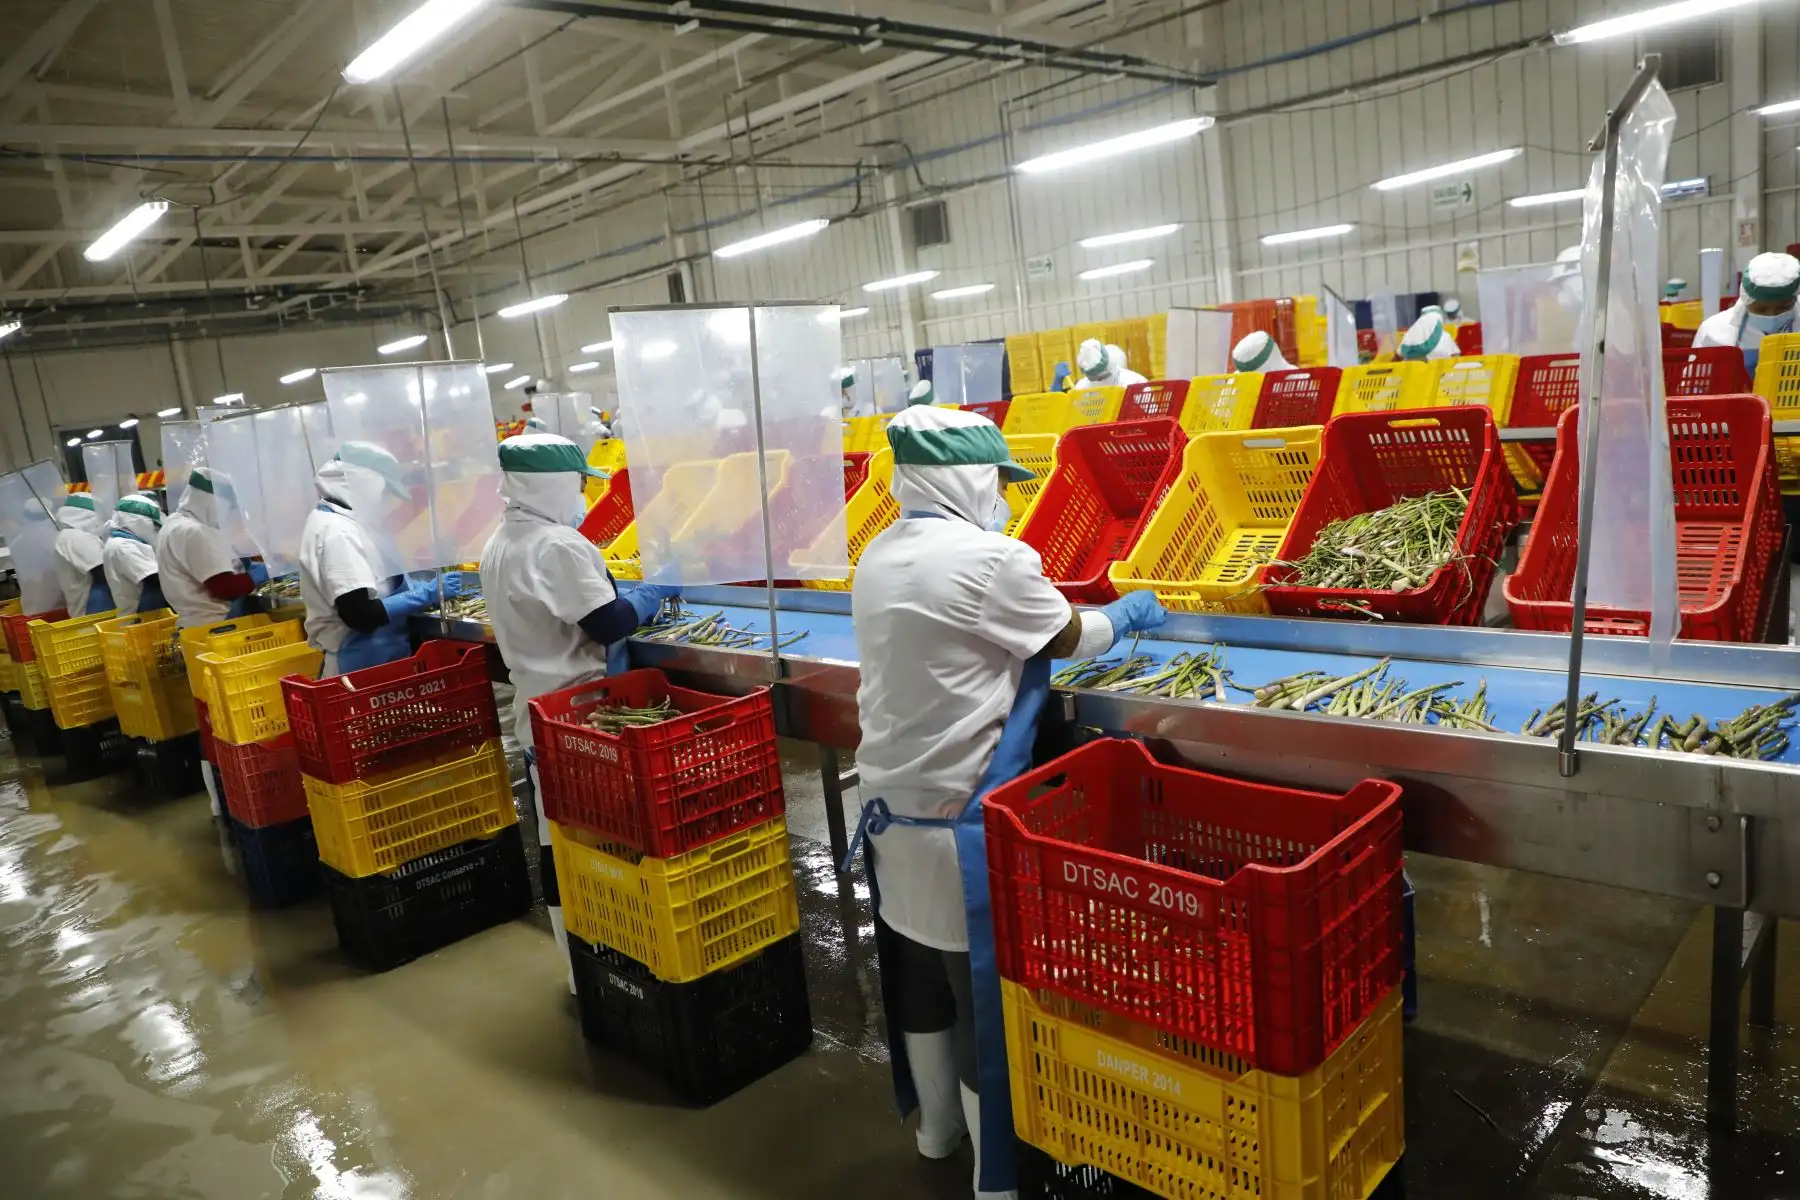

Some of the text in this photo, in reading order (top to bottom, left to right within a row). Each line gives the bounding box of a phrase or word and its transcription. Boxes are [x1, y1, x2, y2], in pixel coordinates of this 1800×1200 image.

[369, 678, 446, 709] DTSAC 2021
[564, 735, 618, 763] DTSAC 2019
[416, 872, 441, 890] DTSAC
[1063, 860, 1198, 917] DTSAC 2019
[608, 972, 629, 992] DTSAC
[1097, 1049, 1182, 1097] DANPER 2014
